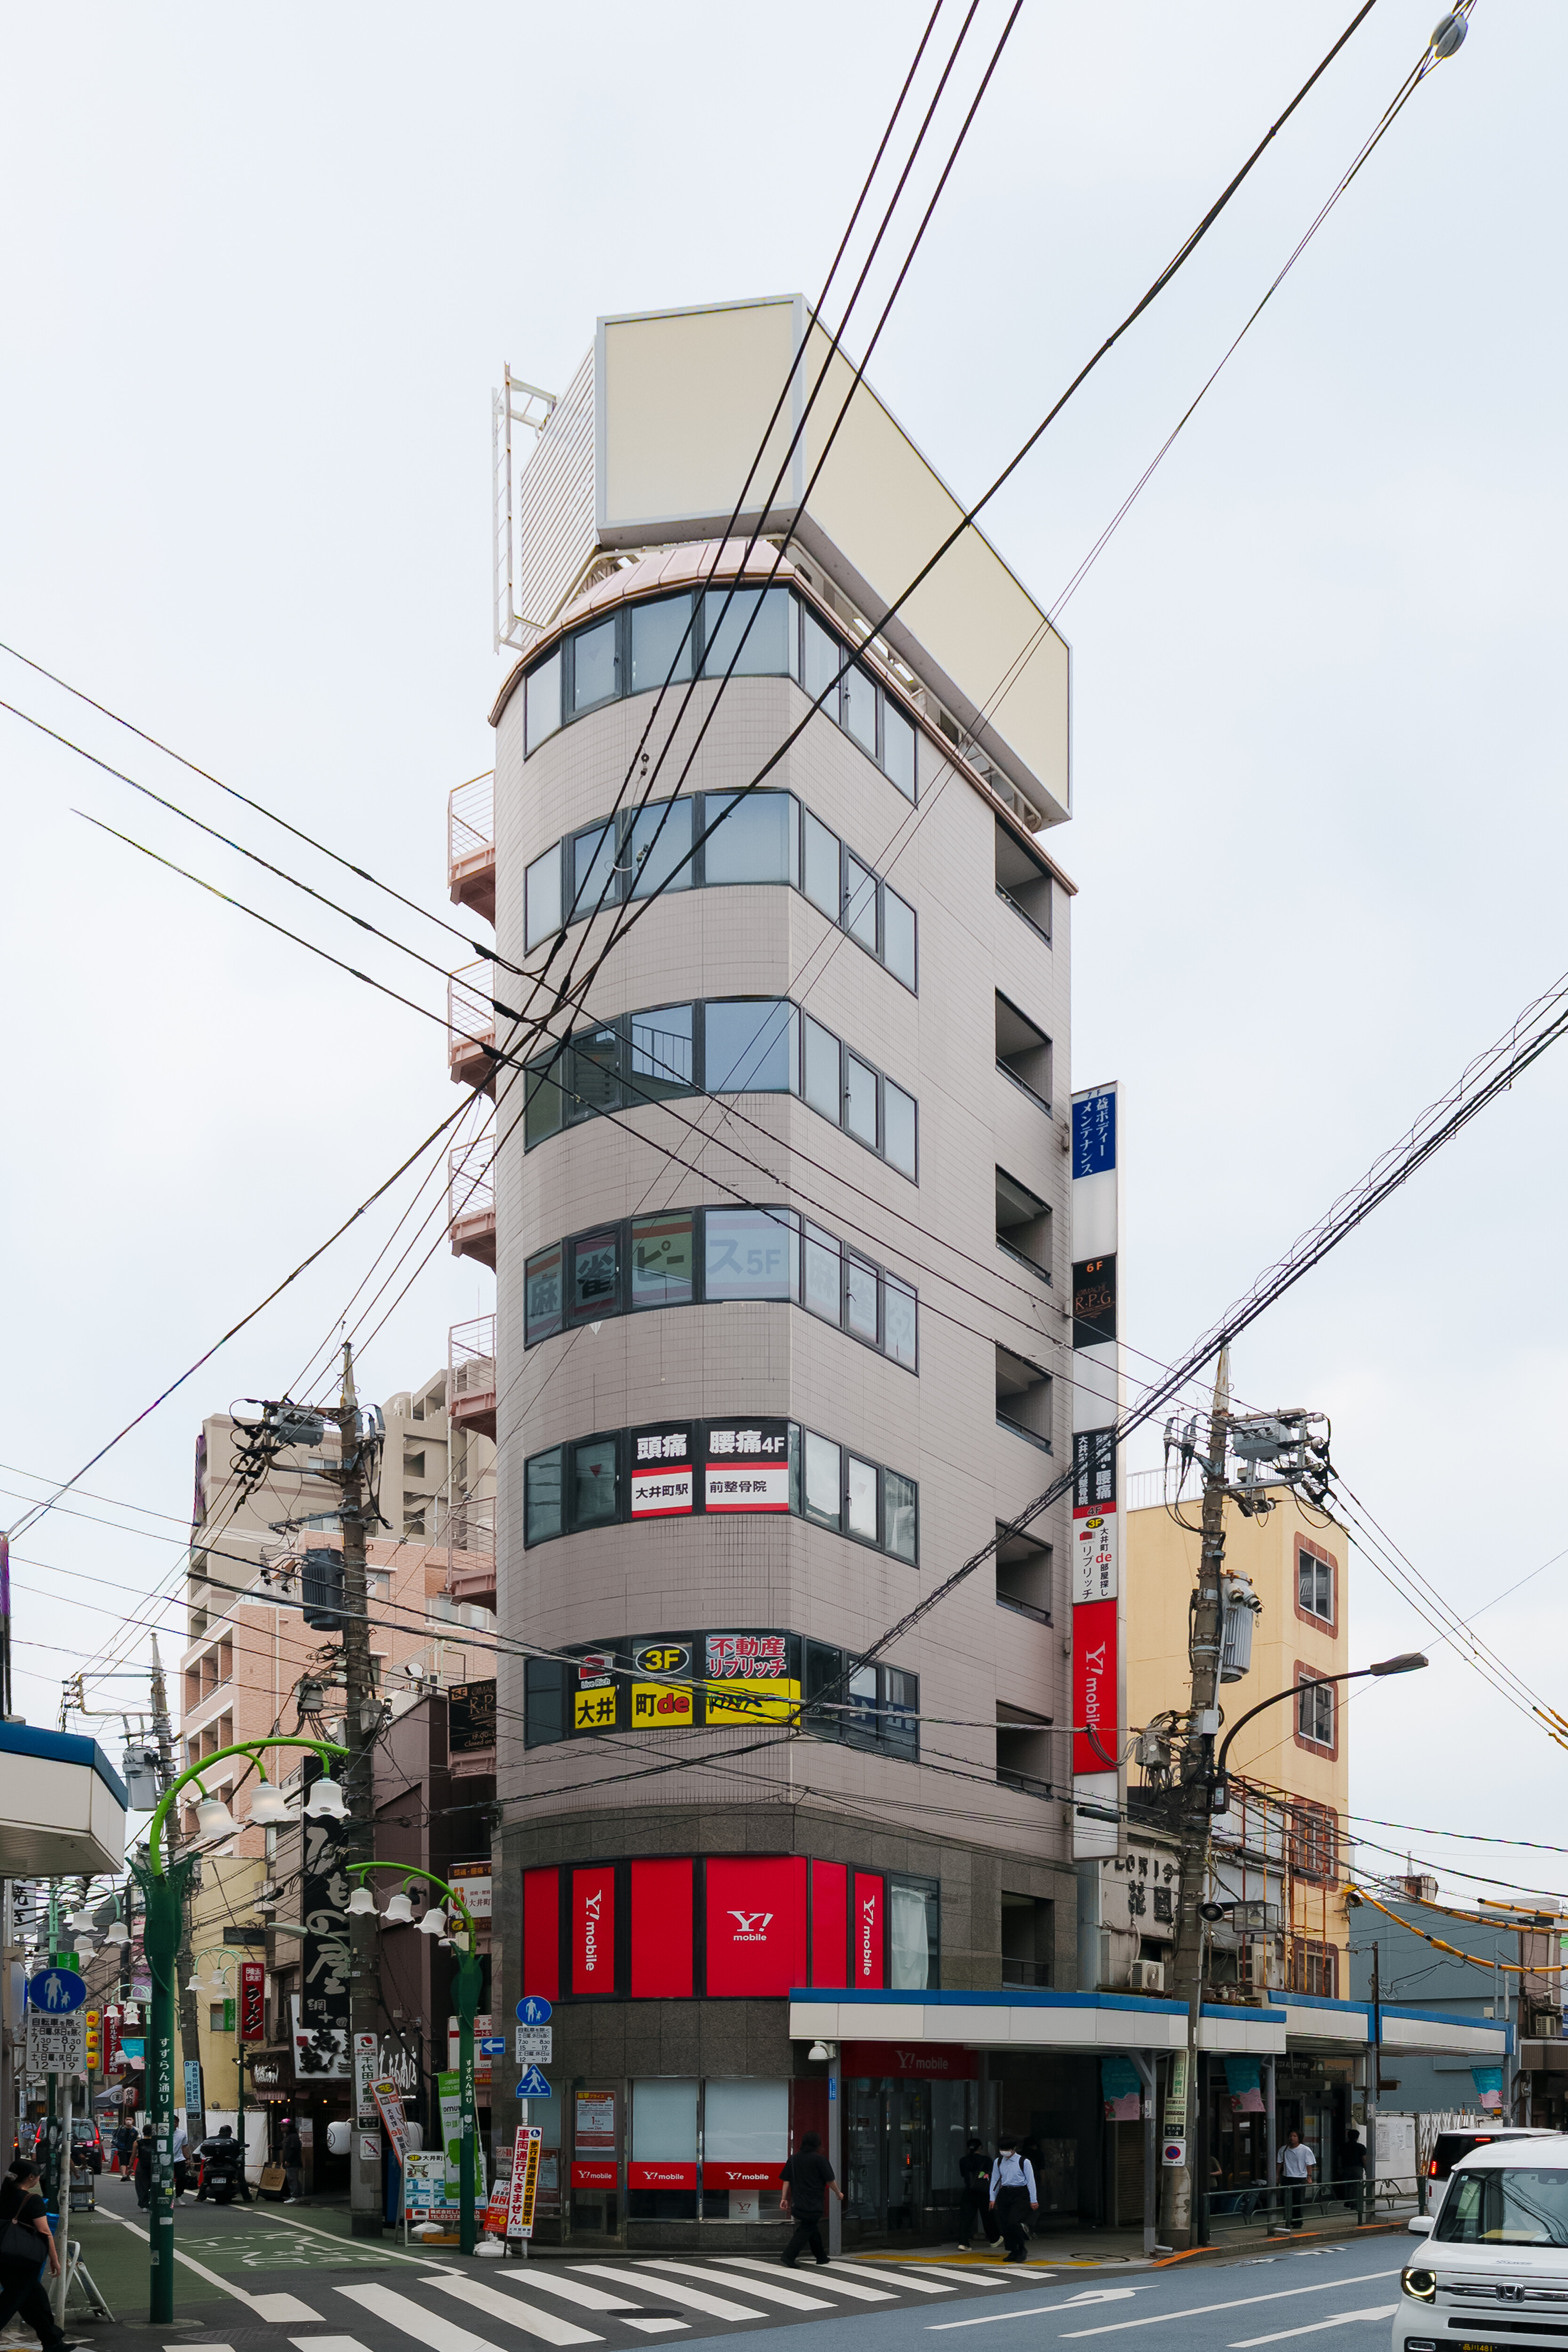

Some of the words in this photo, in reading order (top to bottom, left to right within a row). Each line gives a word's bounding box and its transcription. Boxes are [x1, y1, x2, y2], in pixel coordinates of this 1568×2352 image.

[1096, 1097, 1109, 1157] 益ボディー
[1080, 1101, 1093, 1176] メンテナンス
[1087, 1261, 1103, 1272] 6F
[637, 1434, 687, 1460] 頭痛
[1087, 1505, 1102, 1515] 4F
[1088, 1518, 1102, 1528] 3F
[1082, 1546, 1093, 1599] リブリッチ
[709, 1637, 786, 1658] 不動産
[645, 1649, 680, 1670] 3F
[709, 1658, 786, 1679] リブリッチ
[581, 1679, 596, 1688] Live
[596, 1677, 610, 1687] Rich
[733, 1933, 767, 1941] mobile
[32, 2018, 80, 2026] 自転車を除く
[159, 2038, 170, 2104] すずらん通り
[1174, 2065, 1183, 2094] 山手歯科
[126, 2089, 134, 2106] 焼肉
[510, 2129, 530, 2225] 車両通行できません
[523, 2141, 539, 2225] 歩行者用道路の時間帯は
